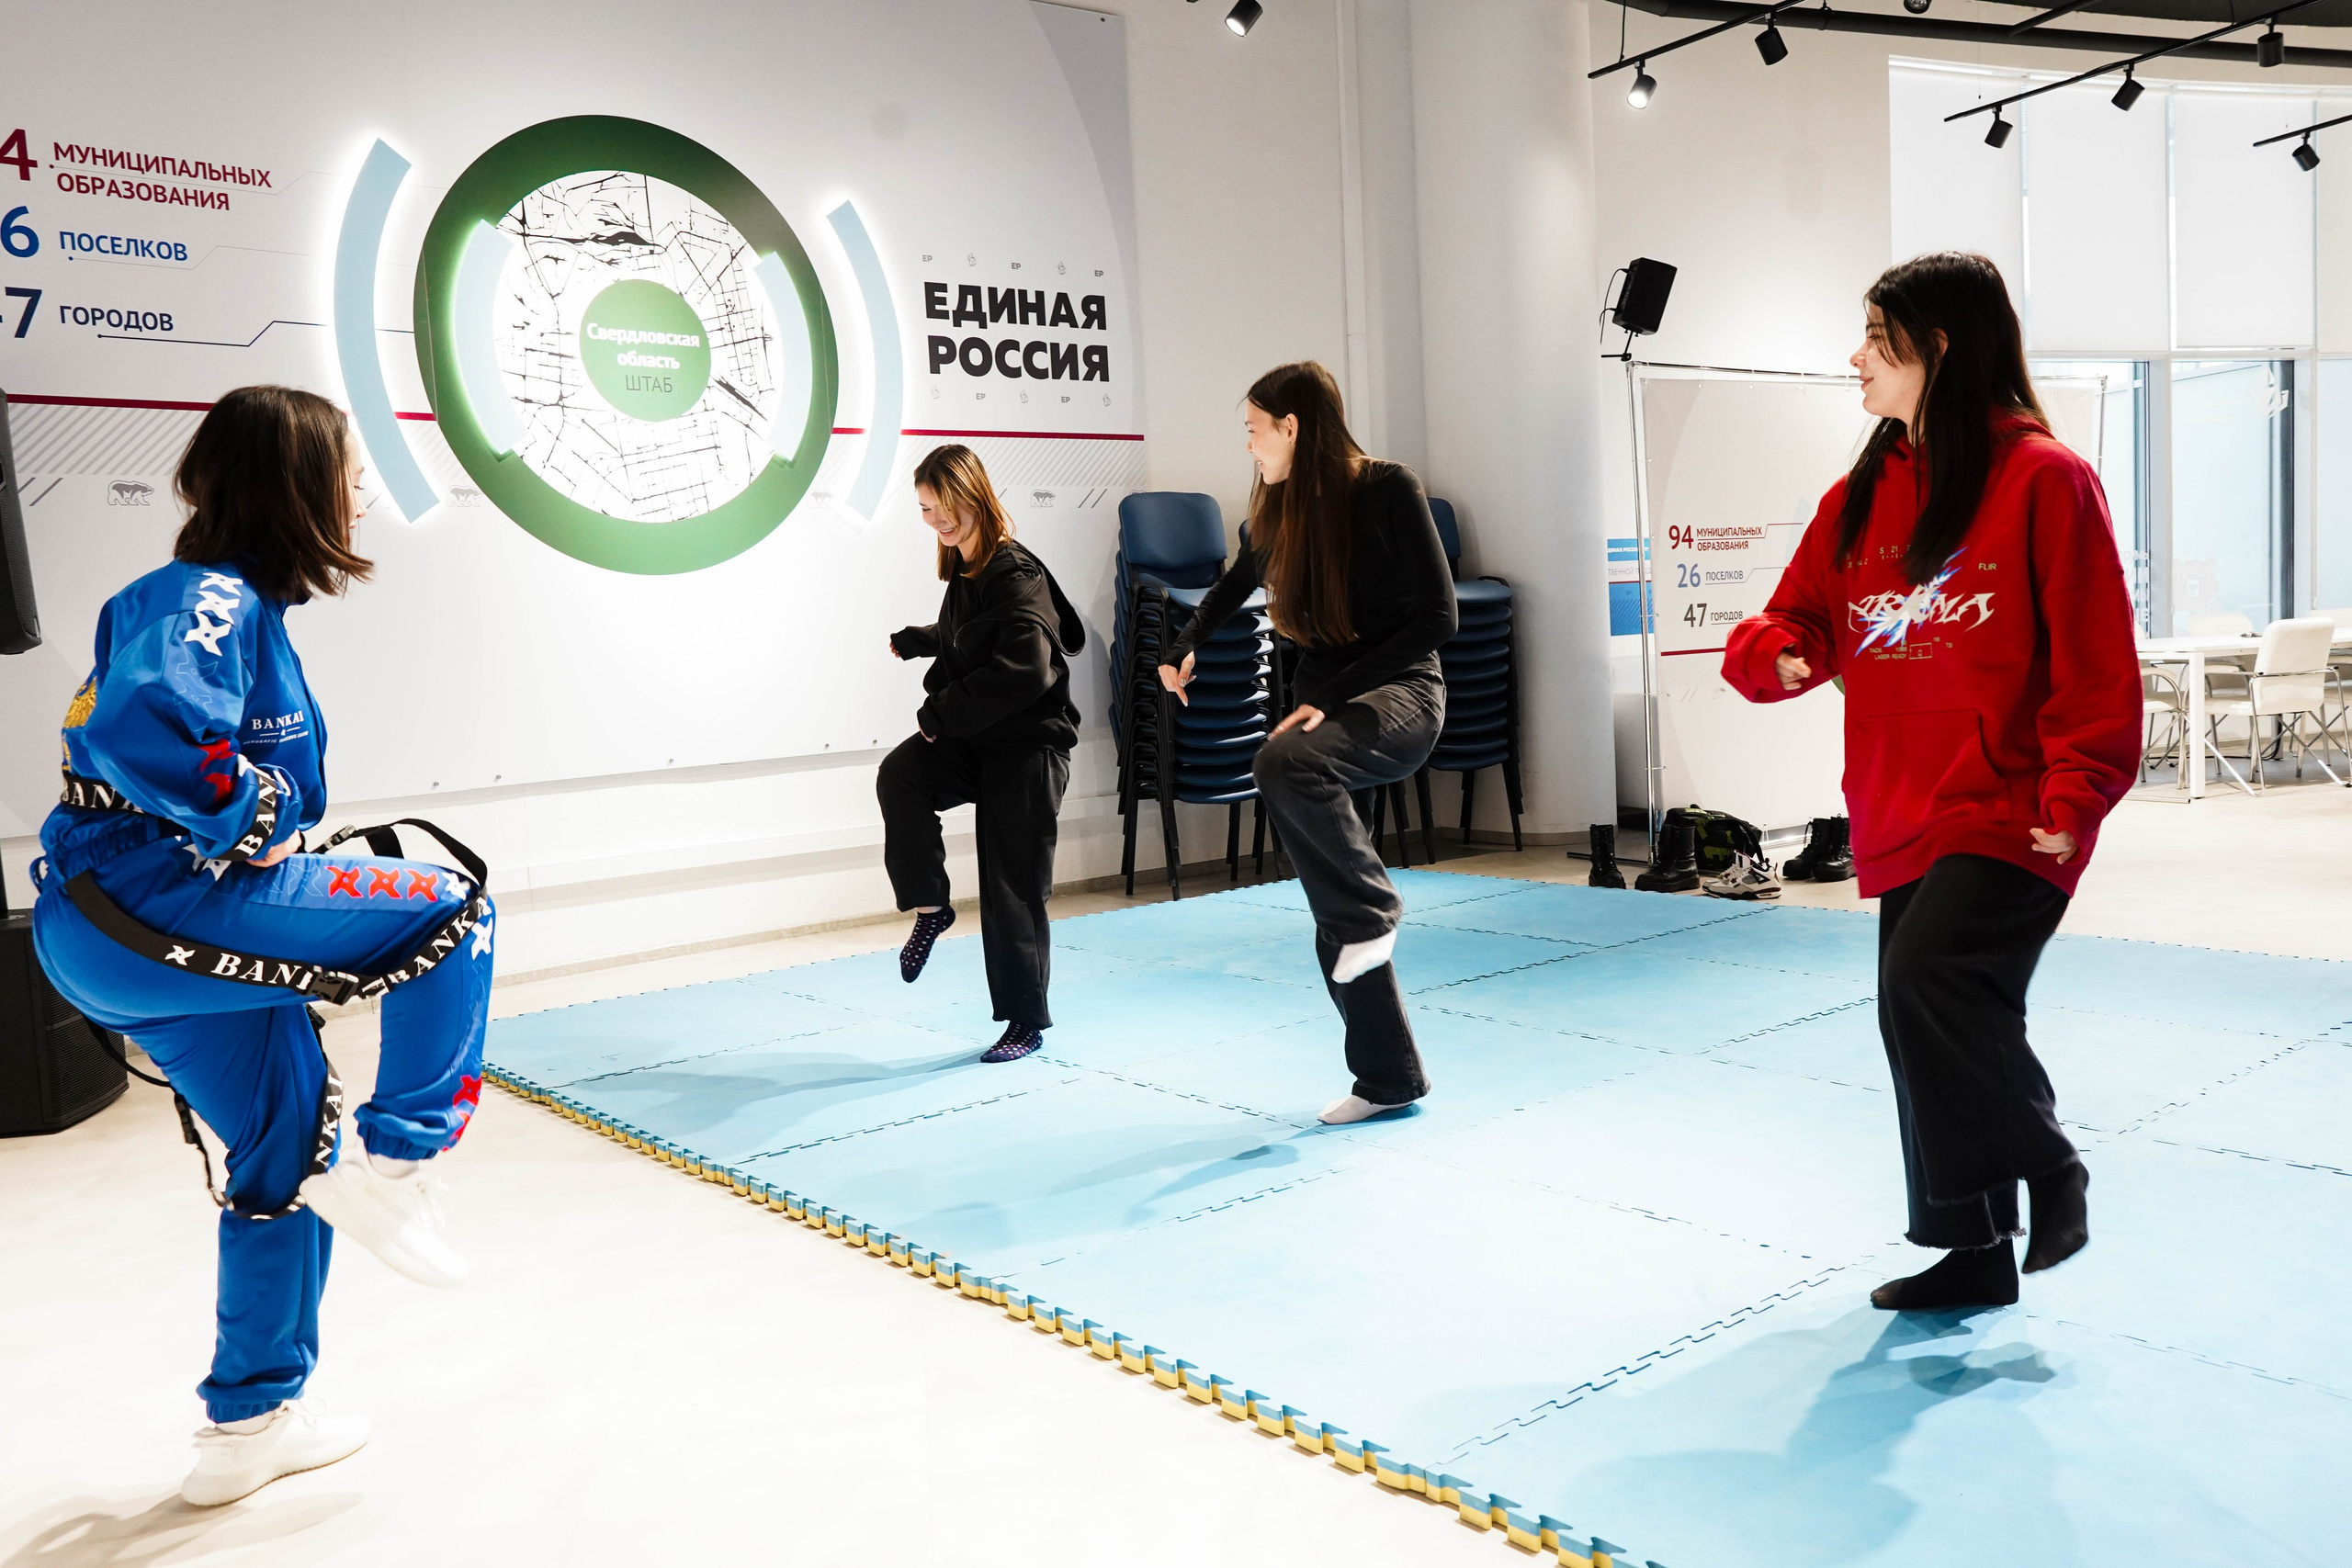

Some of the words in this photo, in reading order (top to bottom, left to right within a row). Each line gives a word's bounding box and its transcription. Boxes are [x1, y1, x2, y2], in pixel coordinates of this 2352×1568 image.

[0, 129, 38, 181] 4
[52, 142, 272, 188] МУНИЦИПАЛЬНЫХ
[56, 173, 230, 211] ОБРАЗОВАНИЯ
[0, 205, 40, 258] 6
[59, 231, 188, 261] ПОСЕЛКОВ
[0, 287, 42, 338] 7
[59, 305, 174, 332] ГОРОДОВ
[923, 281, 1107, 331] ЕДИНАЯ
[586, 322, 700, 347] Свердловская
[616, 350, 680, 369] область
[927, 334, 1110, 382] РОССИЯ
[626, 375, 673, 393] ШТАБ
[1668, 525, 1694, 550] 94
[1696, 526, 1762, 537] МУНИЦИПАЛЬНЫХ
[1697, 540, 1749, 552] ОБРАЗОВАНИЯ
[1607, 566, 1634, 576] ТВЕННОЙ
[1677, 563, 1701, 588] 26
[1705, 570, 1744, 581] ПОСЕЛКОВ
[1978, 562, 1996, 570] FLIR
[1683, 603, 1707, 627] 47
[1711, 611, 1743, 621] ГОРОДОВ
[251, 710, 304, 730] BANKAI
